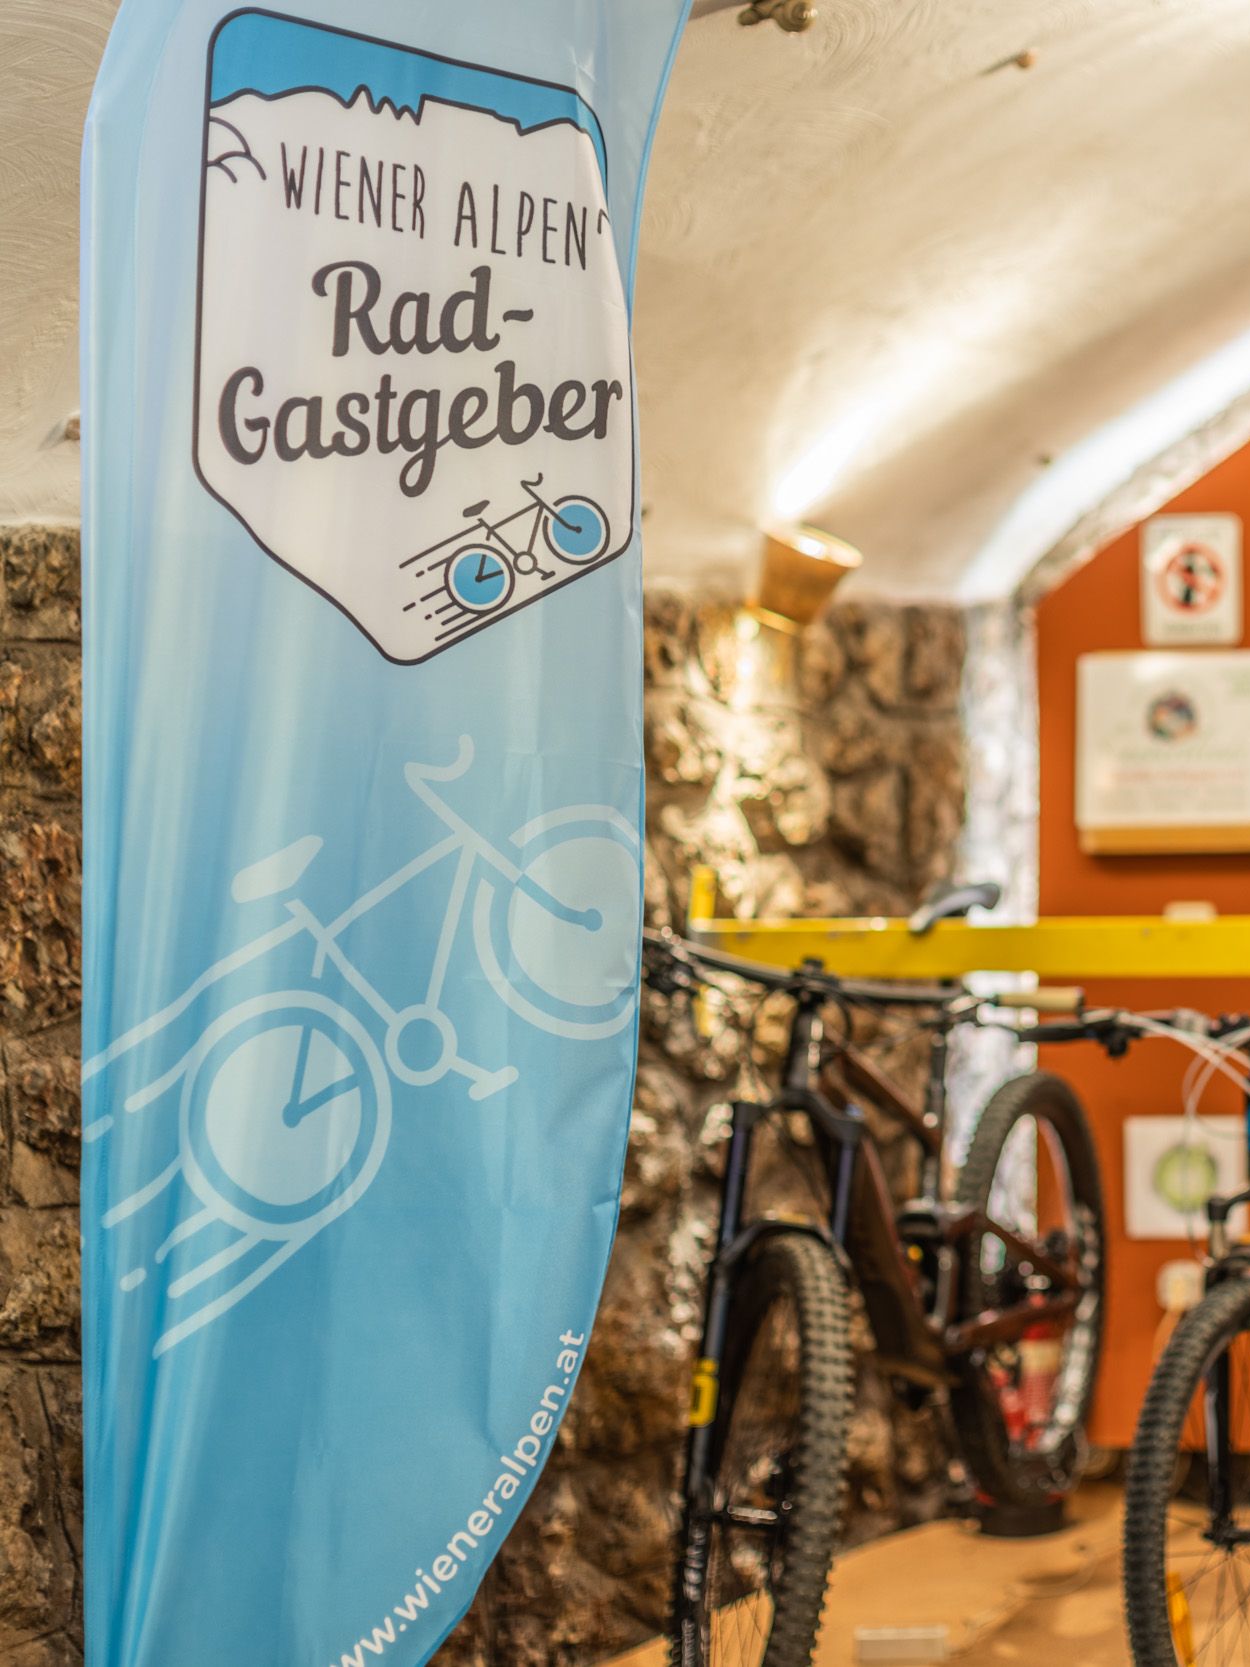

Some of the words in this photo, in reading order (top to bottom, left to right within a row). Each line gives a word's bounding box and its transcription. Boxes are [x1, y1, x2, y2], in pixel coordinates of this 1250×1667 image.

[281, 142, 425, 239] WIENER
[454, 182, 587, 271] ALPEN
[311, 260, 534, 357] Rad-
[218, 359, 622, 498] Gastgeber
